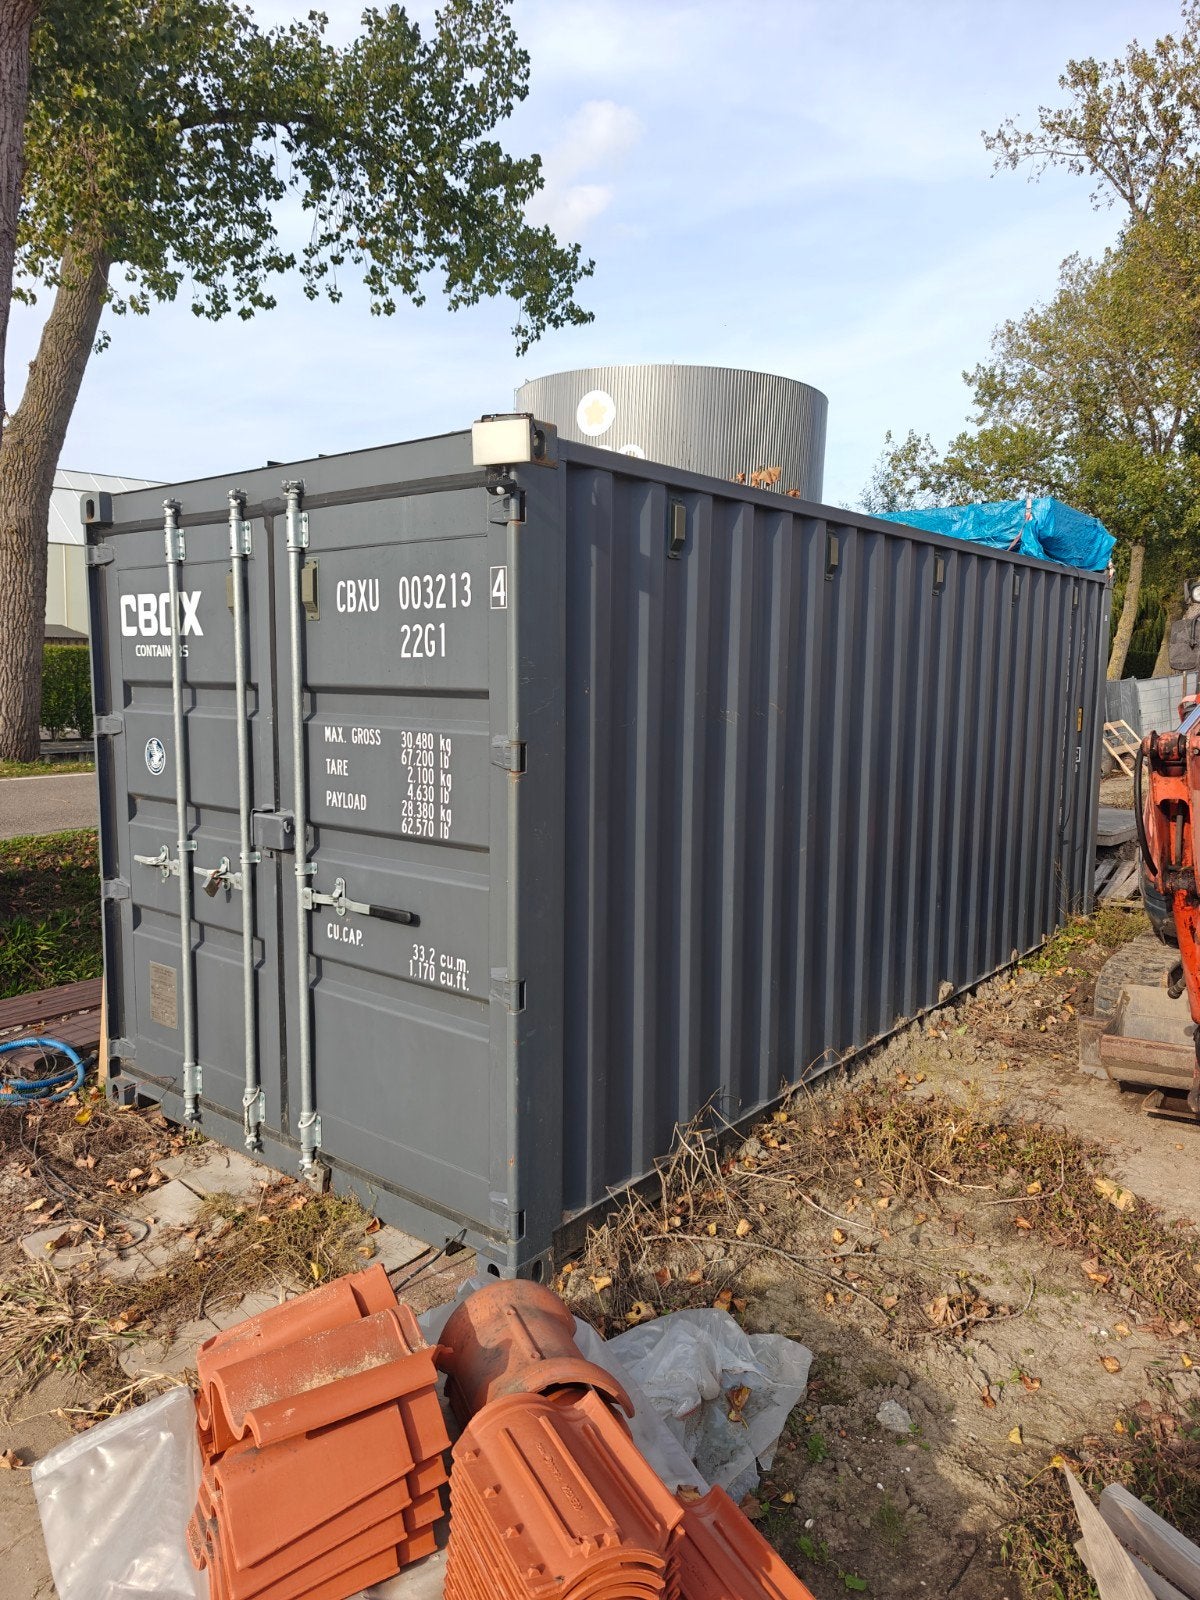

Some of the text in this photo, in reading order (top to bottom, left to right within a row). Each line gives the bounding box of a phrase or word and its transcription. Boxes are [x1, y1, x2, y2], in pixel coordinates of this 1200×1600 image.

[336, 568, 506, 613] CBXU 003213 4
[400, 622, 446, 658] 22G1
[324, 726, 347, 744] MAX.
[351, 727, 382, 746] GROSS
[439, 733, 452, 757] kg
[325, 758, 349, 777] TARE
[439, 769, 452, 792] kg
[439, 751, 450, 769] lb
[326, 790, 367, 811] PAYLOAD
[439, 804, 452, 828] kg
[439, 786, 450, 805] lb
[439, 821, 450, 840] lb
[327, 923, 364, 947] CU.CAP.
[412, 943, 470, 974] 33.2 cu.m.
[439, 970, 470, 992] cu.ft.
